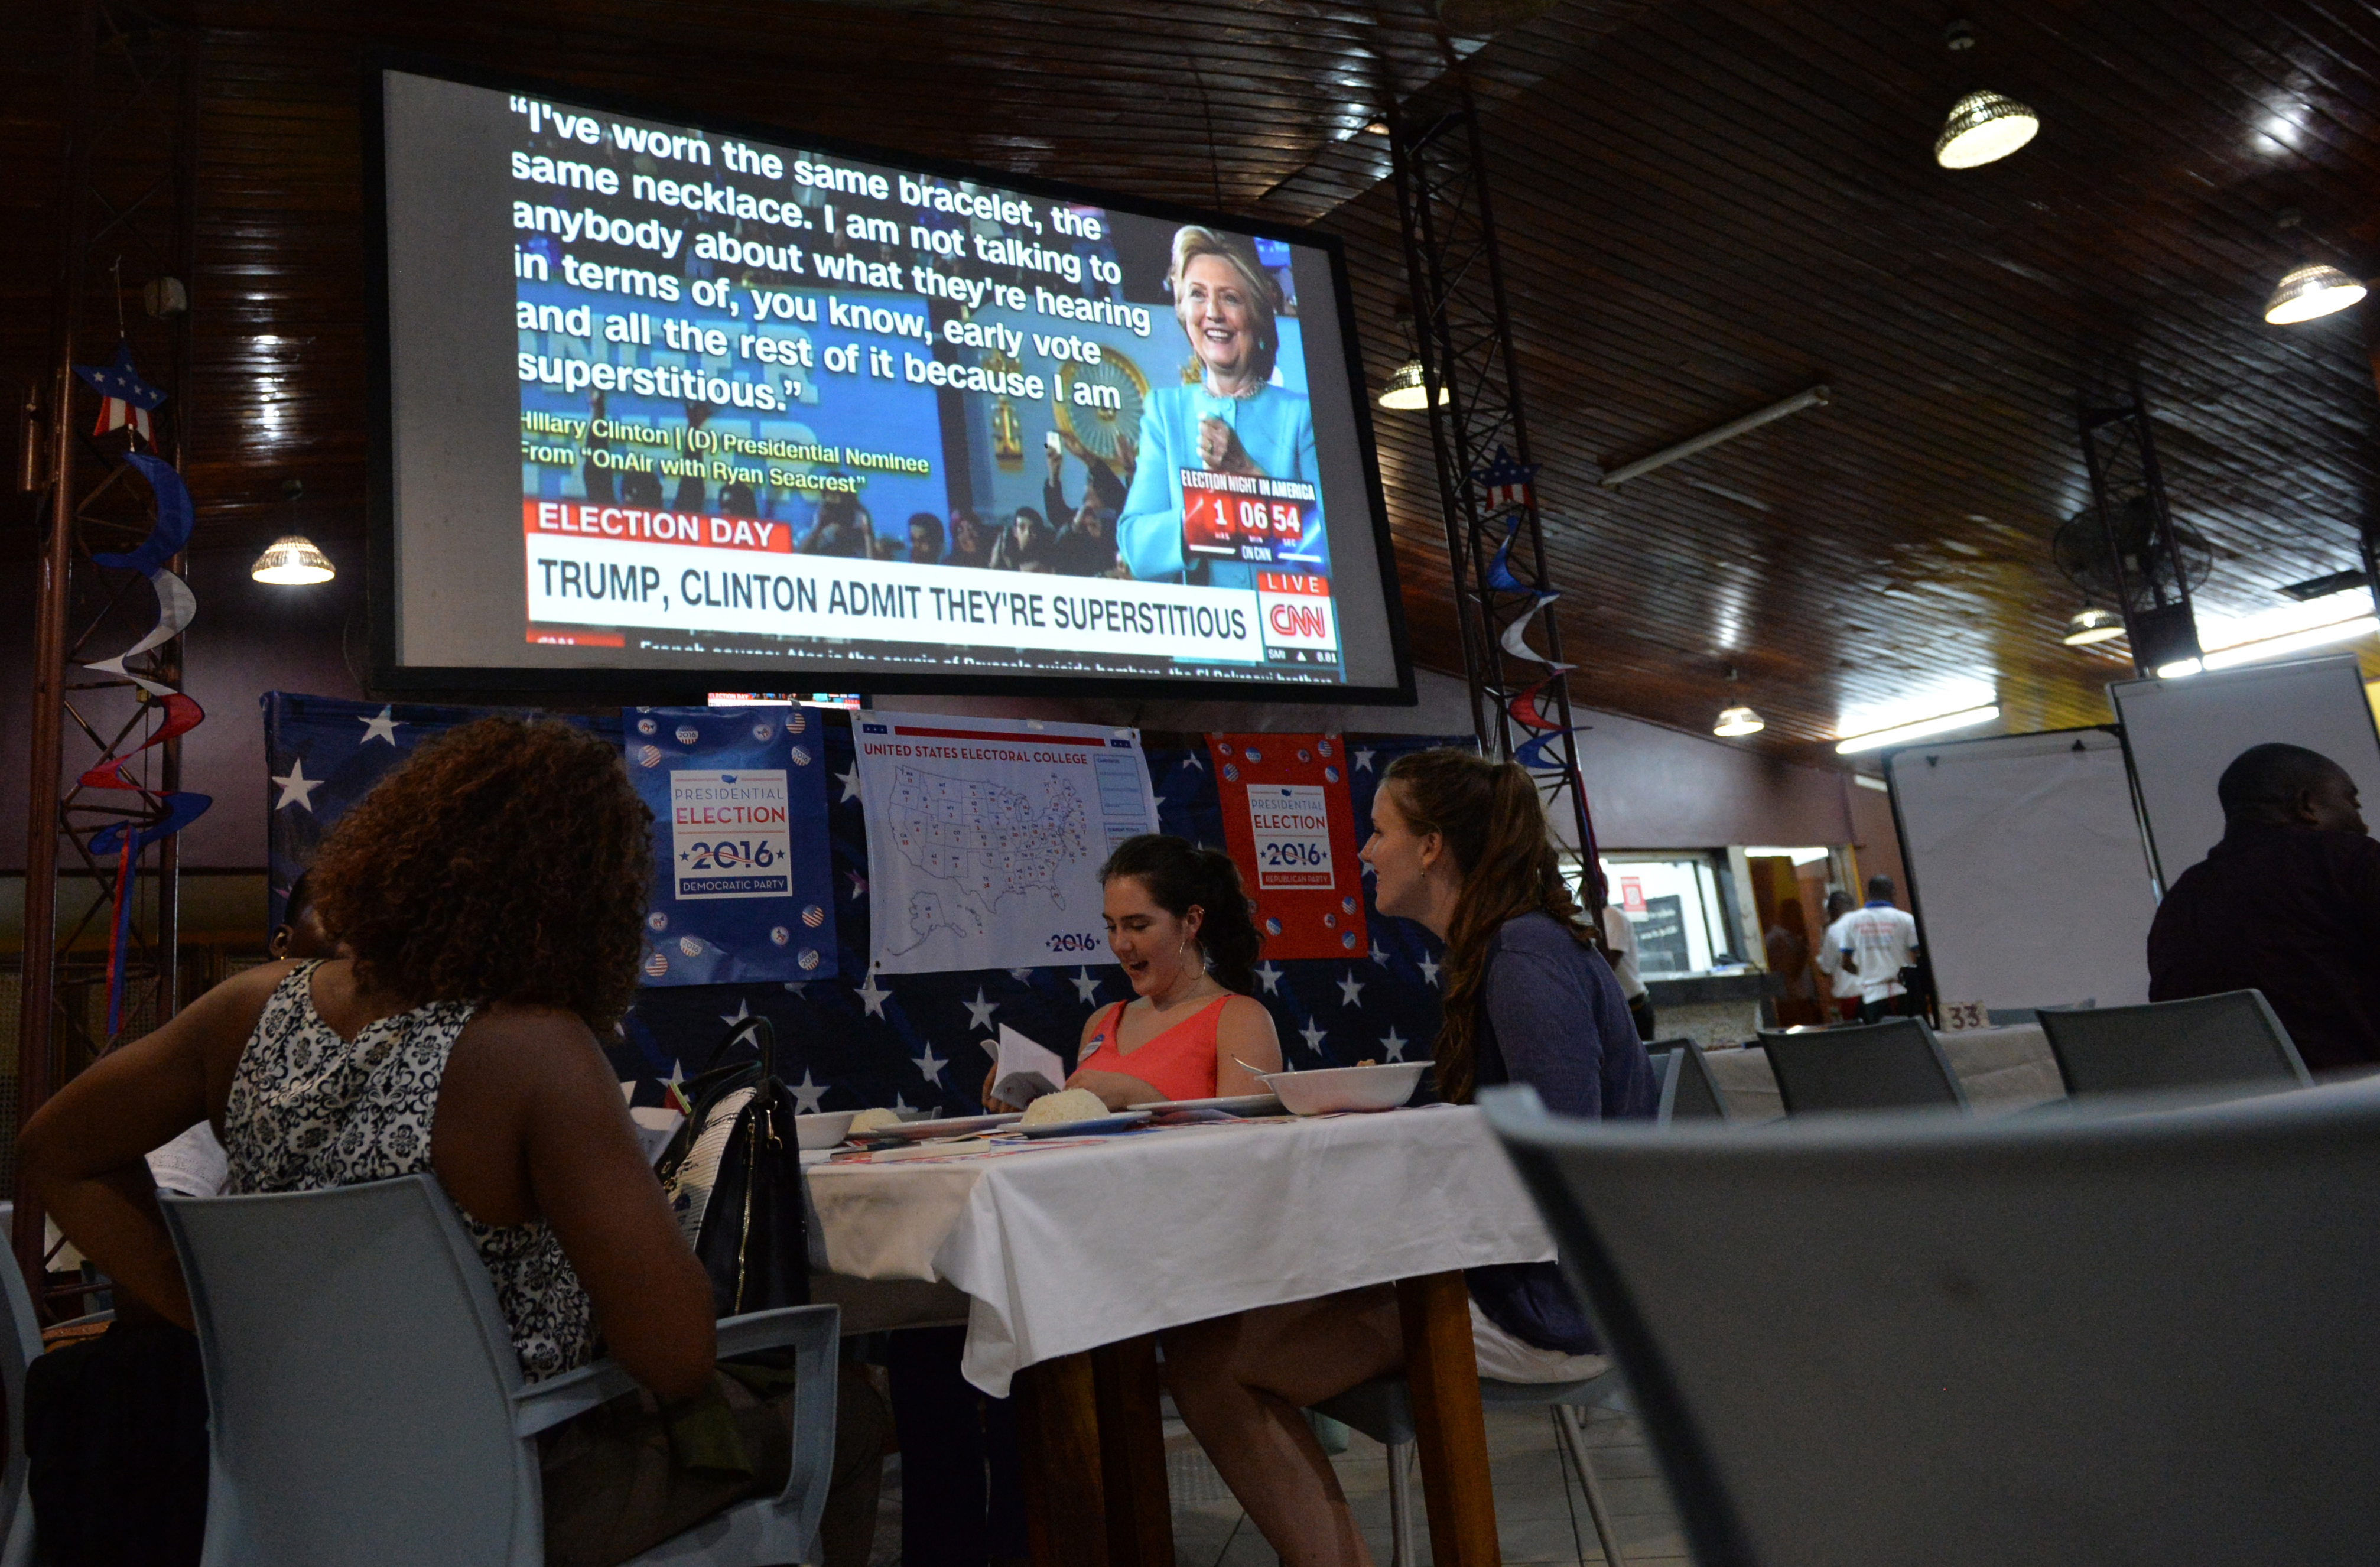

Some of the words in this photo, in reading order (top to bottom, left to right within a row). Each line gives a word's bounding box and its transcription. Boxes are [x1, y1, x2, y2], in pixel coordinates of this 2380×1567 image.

[612, 123, 711, 166] worn
[721, 141, 783, 179] the
[794, 157, 889, 200] same
[899, 175, 1042, 235] bracelet,
[1051, 206, 1101, 240] the
[511, 151, 619, 194] same
[633, 175, 812, 230] necklace.
[824, 204, 834, 233] I
[846, 214, 899, 245] am
[910, 224, 966, 256] not
[974, 233, 1081, 282] talking
[1090, 253, 1121, 285] to
[513, 201, 682, 259] anybody
[694, 230, 803, 274] about
[813, 252, 903, 290] what
[911, 265, 1026, 310] they're
[1036, 285, 1150, 336] hearing
[514, 244, 549, 281] in
[561, 253, 679, 302] terms
[691, 277, 740, 317] of,
[751, 289, 817, 321] you
[830, 297, 933, 345] know,
[944, 318, 1023, 358] early
[1032, 334, 1101, 365] vote
[516, 301, 590, 337] and
[604, 312, 650, 345] all
[663, 317, 728, 356] the
[740, 334, 814, 368] rest
[824, 344, 859, 373] of
[870, 346, 894, 379] it
[905, 352, 1043, 400] because
[1054, 374, 1062, 401] I
[1074, 380, 1121, 409] am
[592, 419, 669, 444] Clinton
[687, 427, 718, 454] (D)
[723, 434, 840, 464] Presidential
[846, 447, 929, 474] Nominee
[661, 459, 707, 478] with
[712, 461, 763, 485] Ryan
[1181, 470, 1227, 490] ELECTION
[1228, 475, 1257, 494] NIGHT
[1259, 478, 1270, 496] IN
[1272, 480, 1316, 501] AMERICA
[538, 502, 699, 541] ELECTION
[710, 519, 773, 547] DAY
[1214, 499, 1227, 525] 1
[1239, 501, 1268, 529] 06
[1272, 505, 1300, 532] 54
[1267, 573, 1319, 593] LIVE
[538, 558, 670, 612] TRUMP,
[680, 568, 817, 613] CLINTON
[828, 581, 921, 622] ADMIT
[928, 587, 1045, 628] THEY'RE
[1054, 596, 1247, 641] SUPERSTITIOUS
[1270, 604, 1325, 638] CNN
[792, 750, 809, 763] 2016
[863, 742, 912, 757] UNITED
[915, 745, 958, 759] STATES
[961, 747, 1030, 763] ELECTORAL
[1033, 752, 1088, 765] COLLEGE
[675, 788, 784, 800] PRESIDENTIAL
[1251, 799, 1323, 810] PRESIDENTIAL
[676, 806, 786, 824] ELECTION
[1254, 814, 1325, 829] ELECTION
[691, 840, 774, 870] 2016
[1267, 843, 1321, 866] 2016
[683, 880, 751, 892] DEMOCRATIC
[753, 879, 785, 890] PARTY
[682, 940, 700, 954] 2016
[1051, 932, 1096, 952] 2016
[801, 951, 817, 967] 2016
[1948, 1004, 1980, 1029] 33
